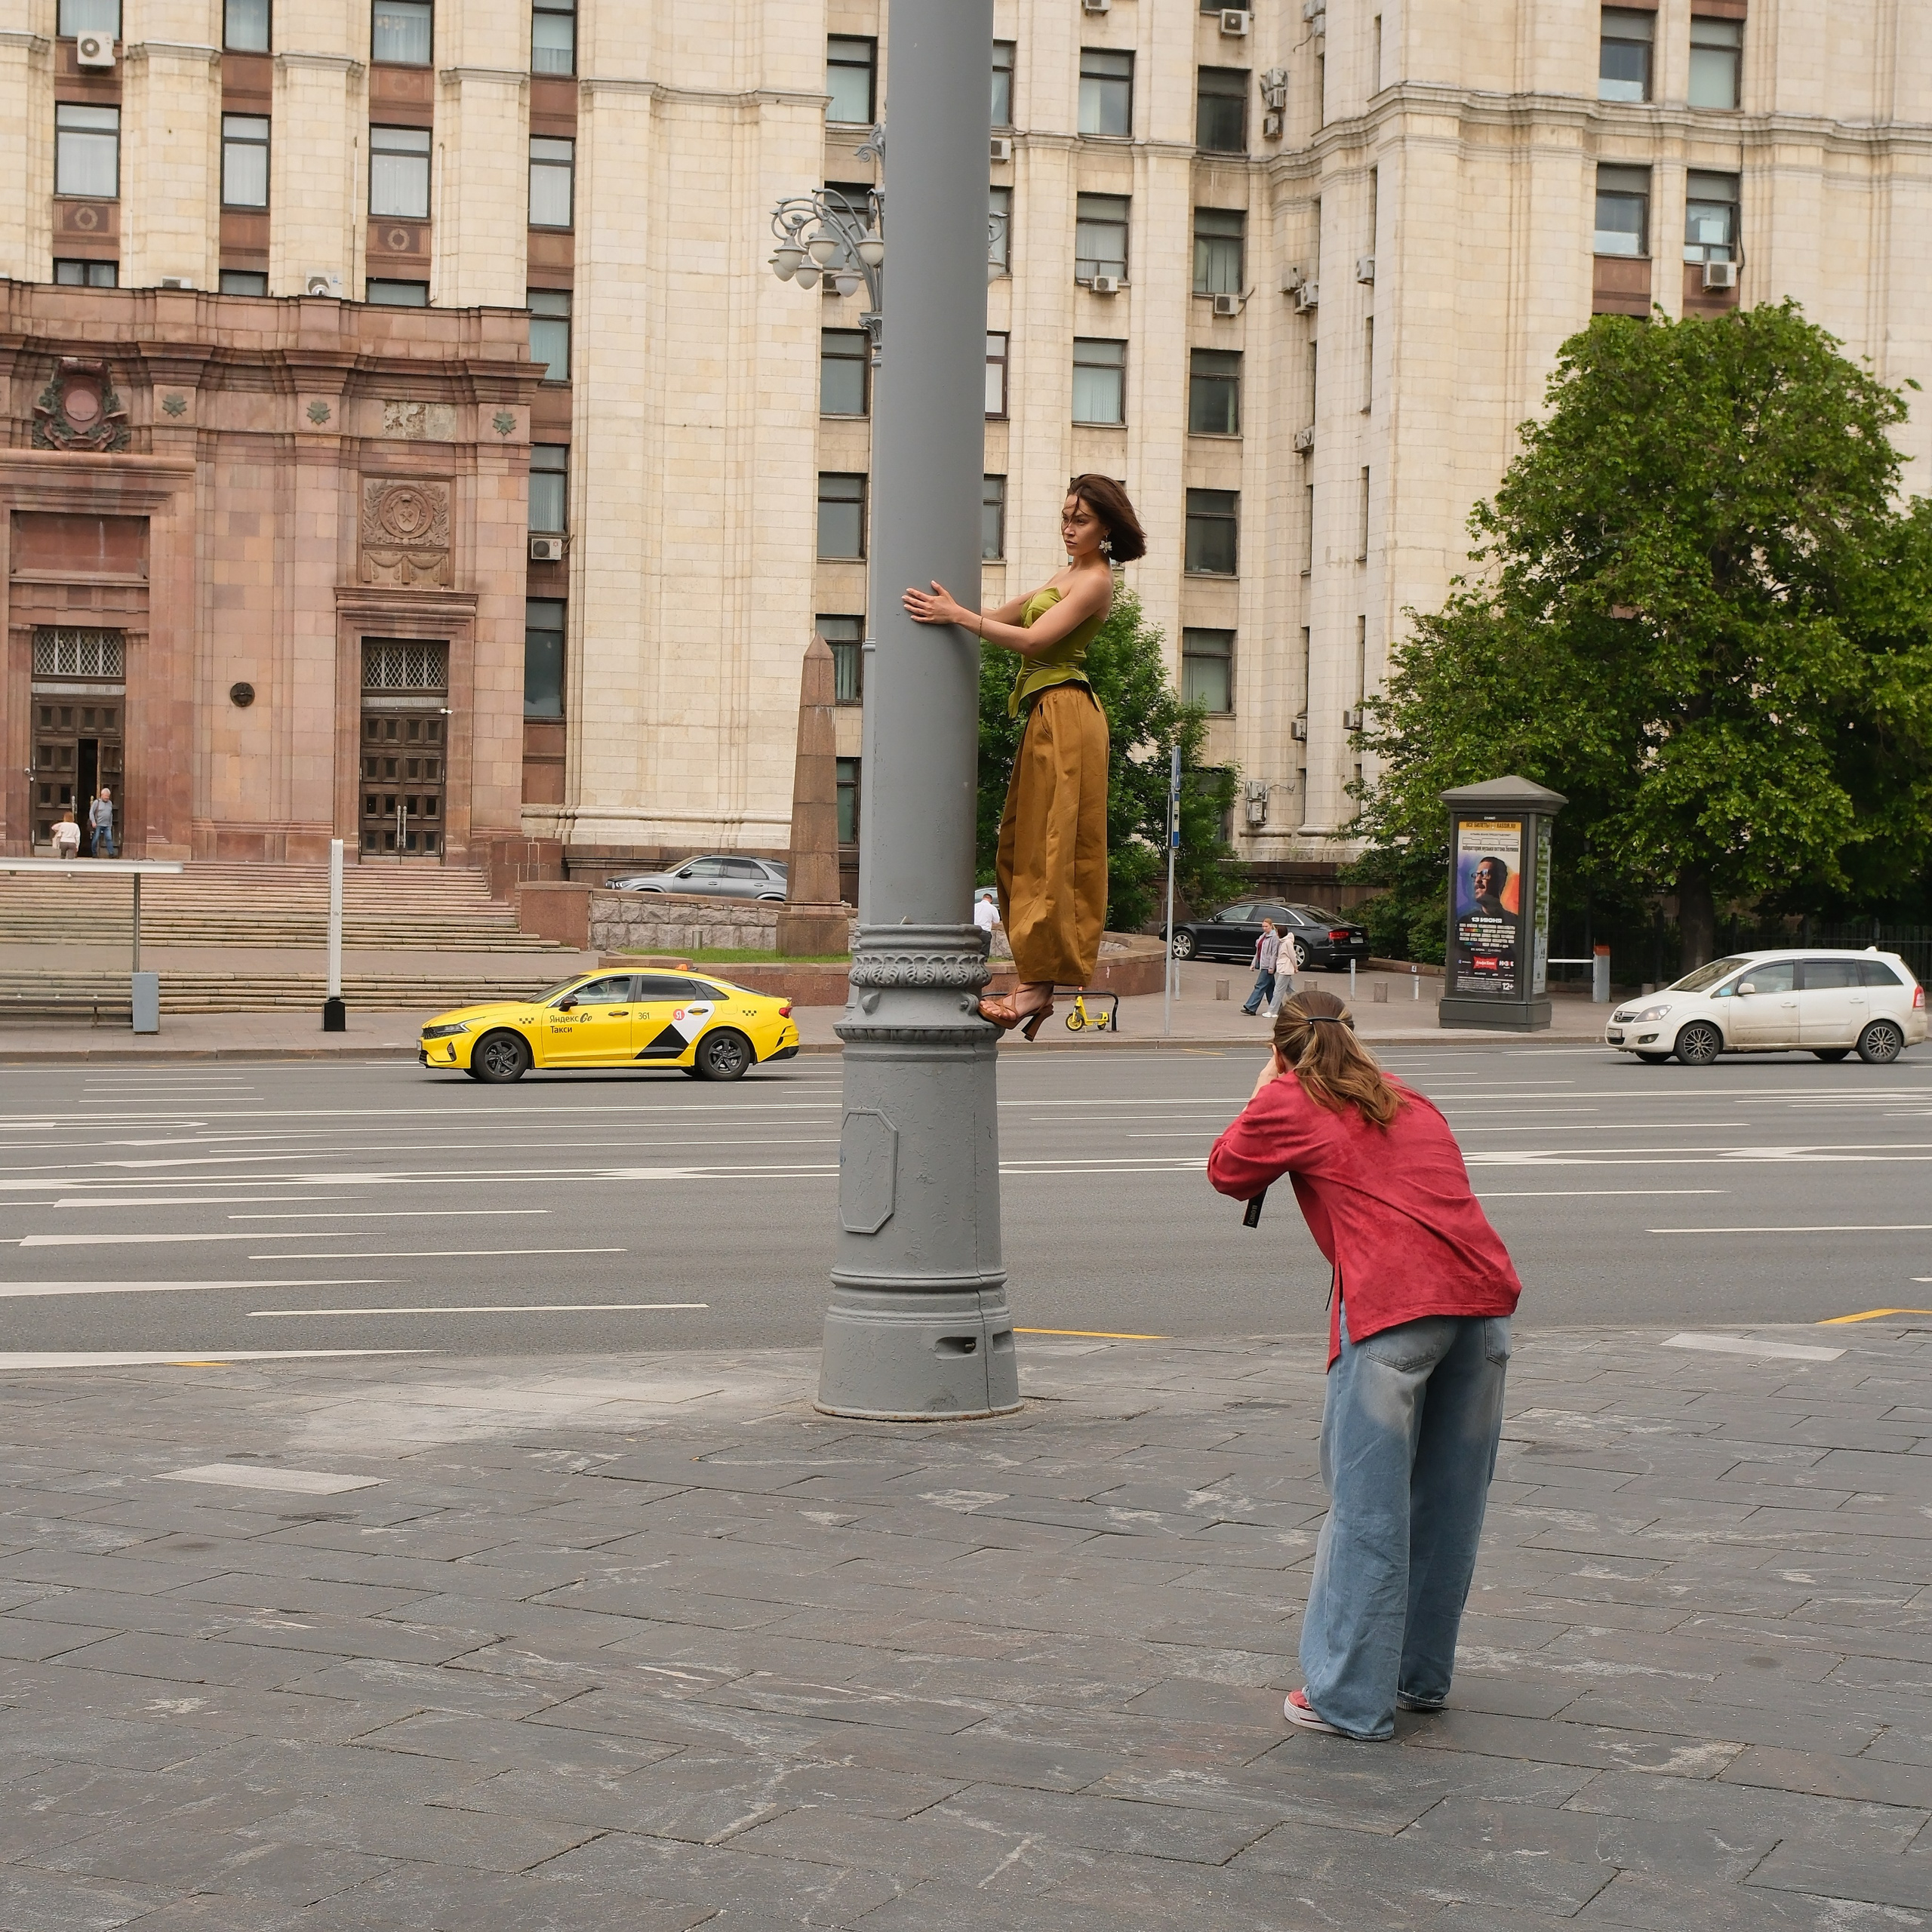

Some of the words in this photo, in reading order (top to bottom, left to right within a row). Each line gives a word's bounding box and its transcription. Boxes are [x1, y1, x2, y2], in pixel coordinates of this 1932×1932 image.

[549, 1015, 579, 1023] Яндекс
[580, 1013, 592, 1023] Go
[1247, 1205, 1257, 1224] Canon
